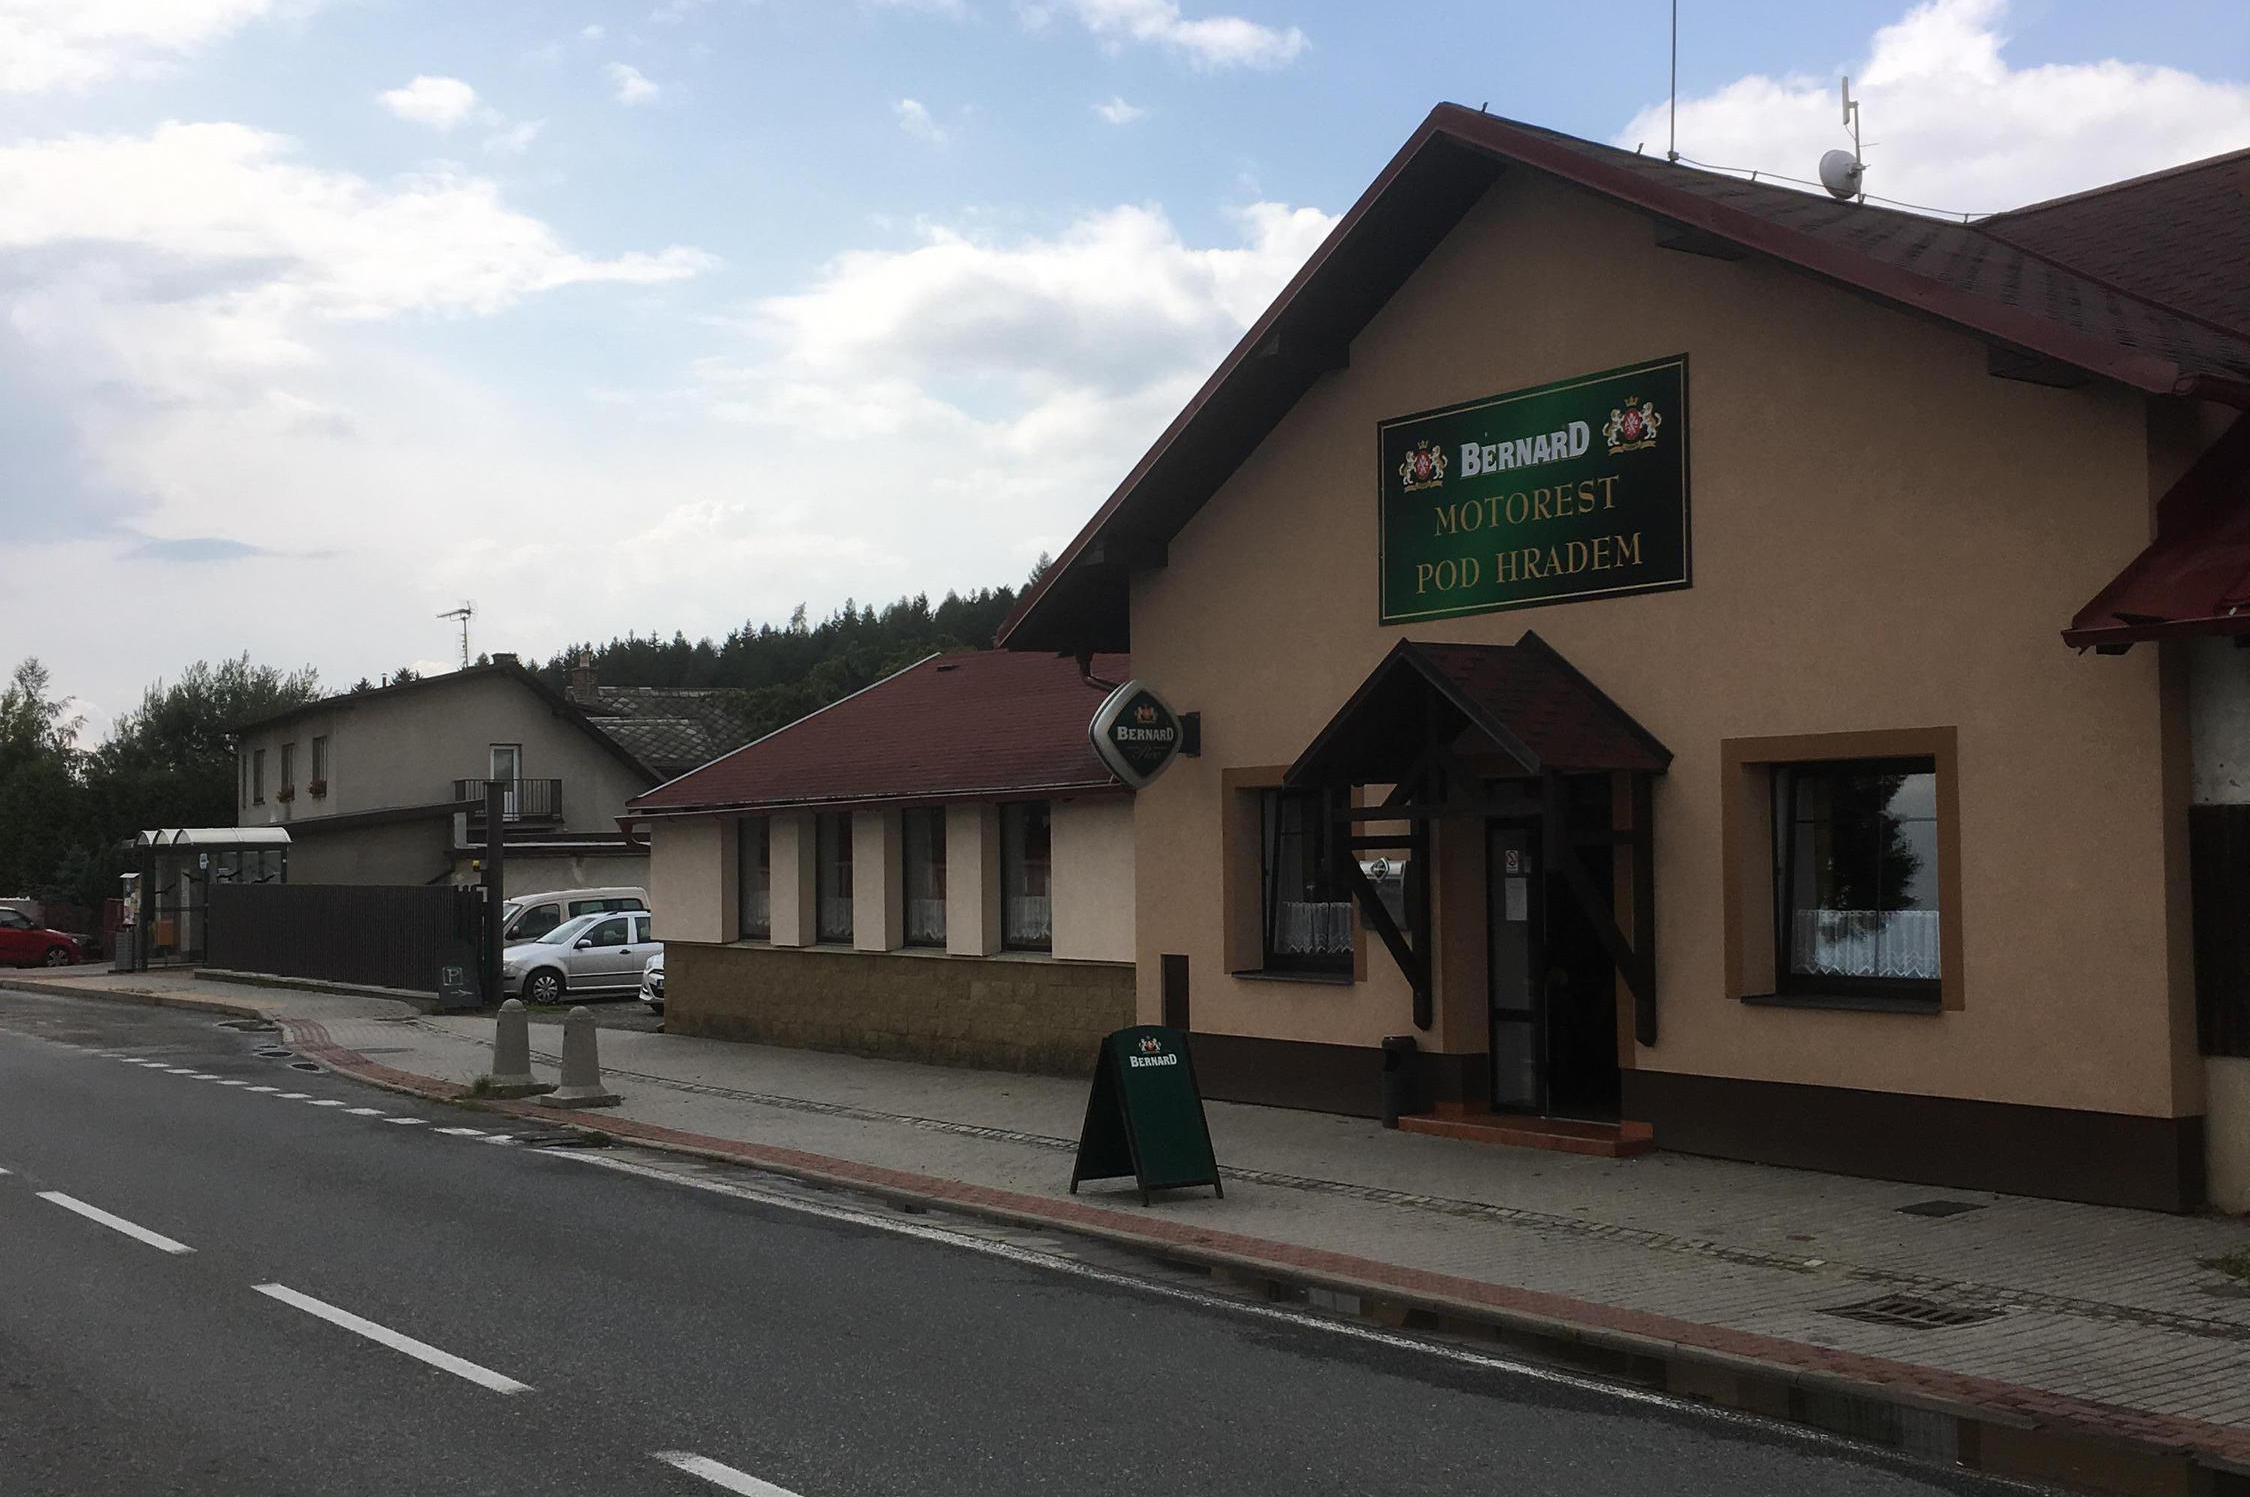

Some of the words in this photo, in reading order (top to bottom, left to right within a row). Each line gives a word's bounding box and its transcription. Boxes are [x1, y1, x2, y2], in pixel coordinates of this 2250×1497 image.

[1460, 420, 1590, 478] BERNARD
[1434, 475, 1619, 537] MOTOREST
[1416, 557, 1480, 594] POD
[1496, 532, 1643, 584] HRADEM
[1117, 726, 1174, 741] BERNARD
[1129, 1053, 1178, 1068] BERNARD
